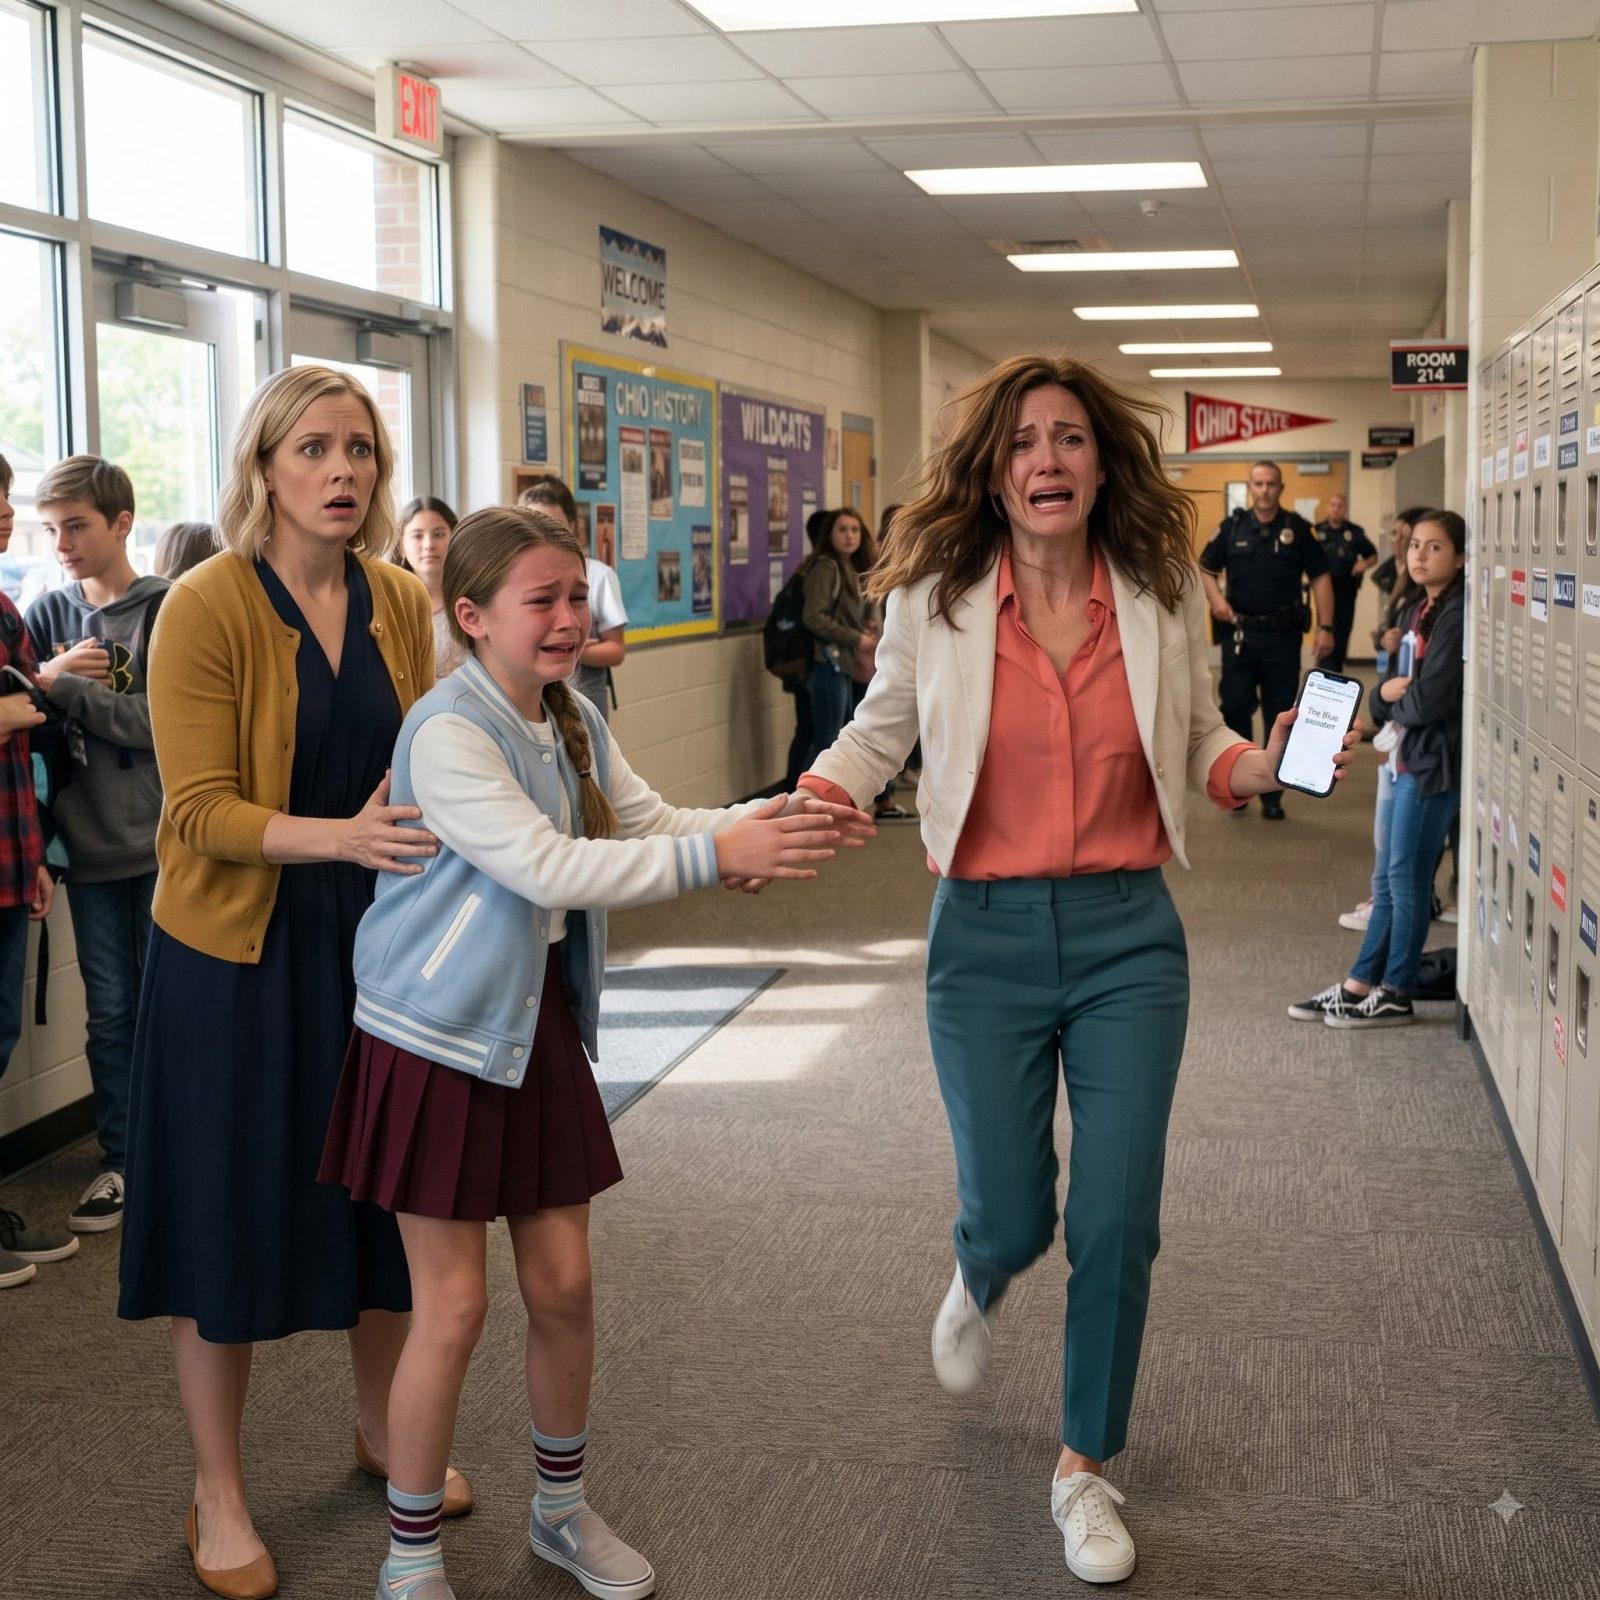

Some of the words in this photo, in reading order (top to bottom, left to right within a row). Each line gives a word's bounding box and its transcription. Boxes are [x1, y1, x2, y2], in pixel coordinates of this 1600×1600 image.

[400, 75, 436, 144] EXIT
[601, 262, 665, 311] WELCOME
[1406, 352, 1456, 367] ROOM
[1417, 367, 1445, 383] 214
[740, 401, 811, 452] WILDCATS
[1195, 403, 1237, 444] OHIO
[1240, 405, 1291, 440] STATE
